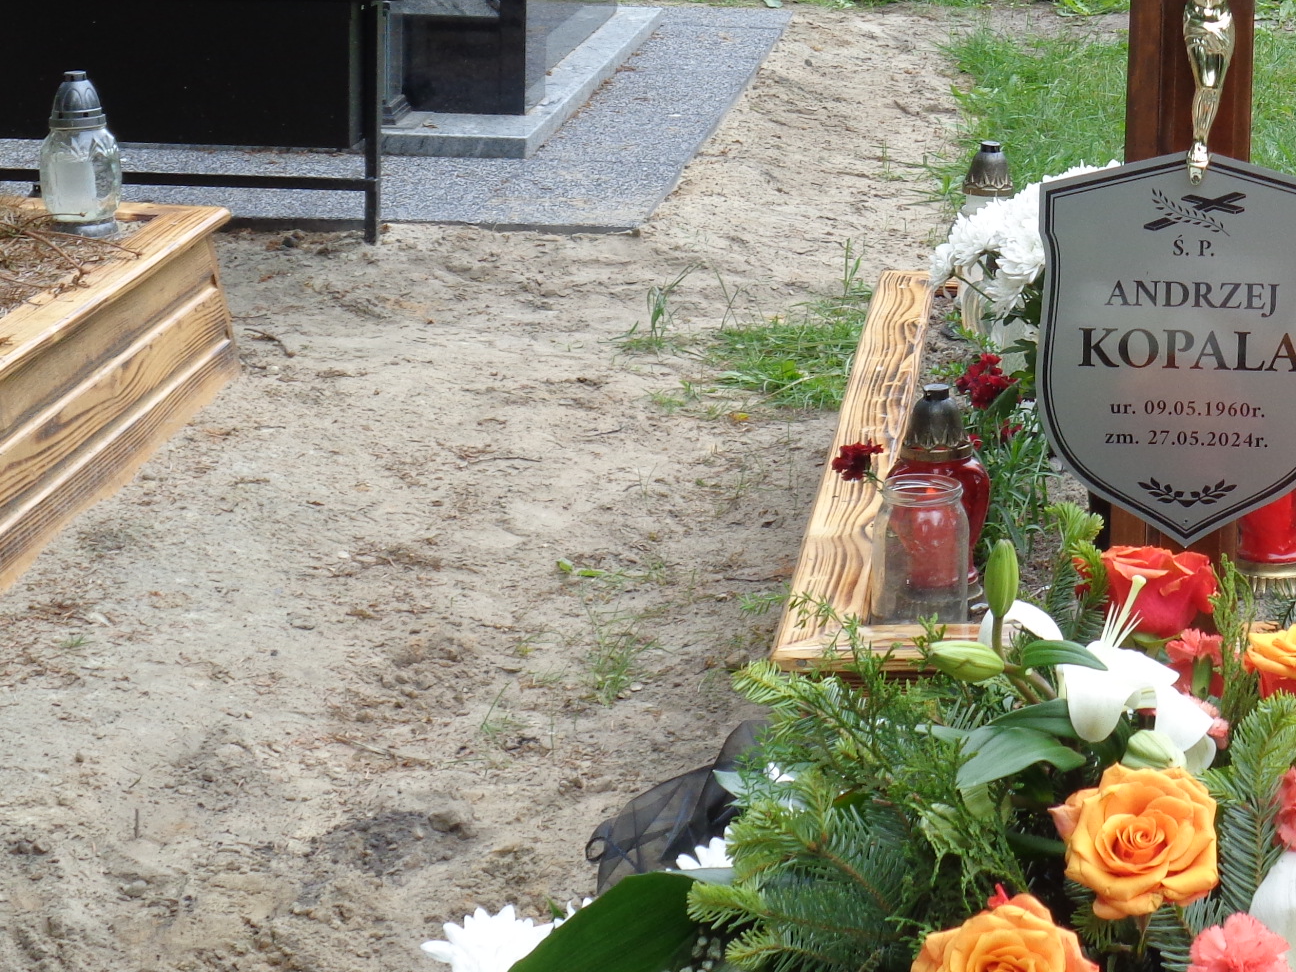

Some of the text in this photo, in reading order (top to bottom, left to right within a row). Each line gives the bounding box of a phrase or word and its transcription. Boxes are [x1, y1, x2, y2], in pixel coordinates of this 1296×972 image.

[1172, 234, 1215, 257] Ś. P.
[1104, 279, 1280, 318] ANDRZEJ
[1109, 400, 1266, 418] ur. 09.05.1960r.
[1104, 430, 1269, 448] zm. 27.05.2024r.
